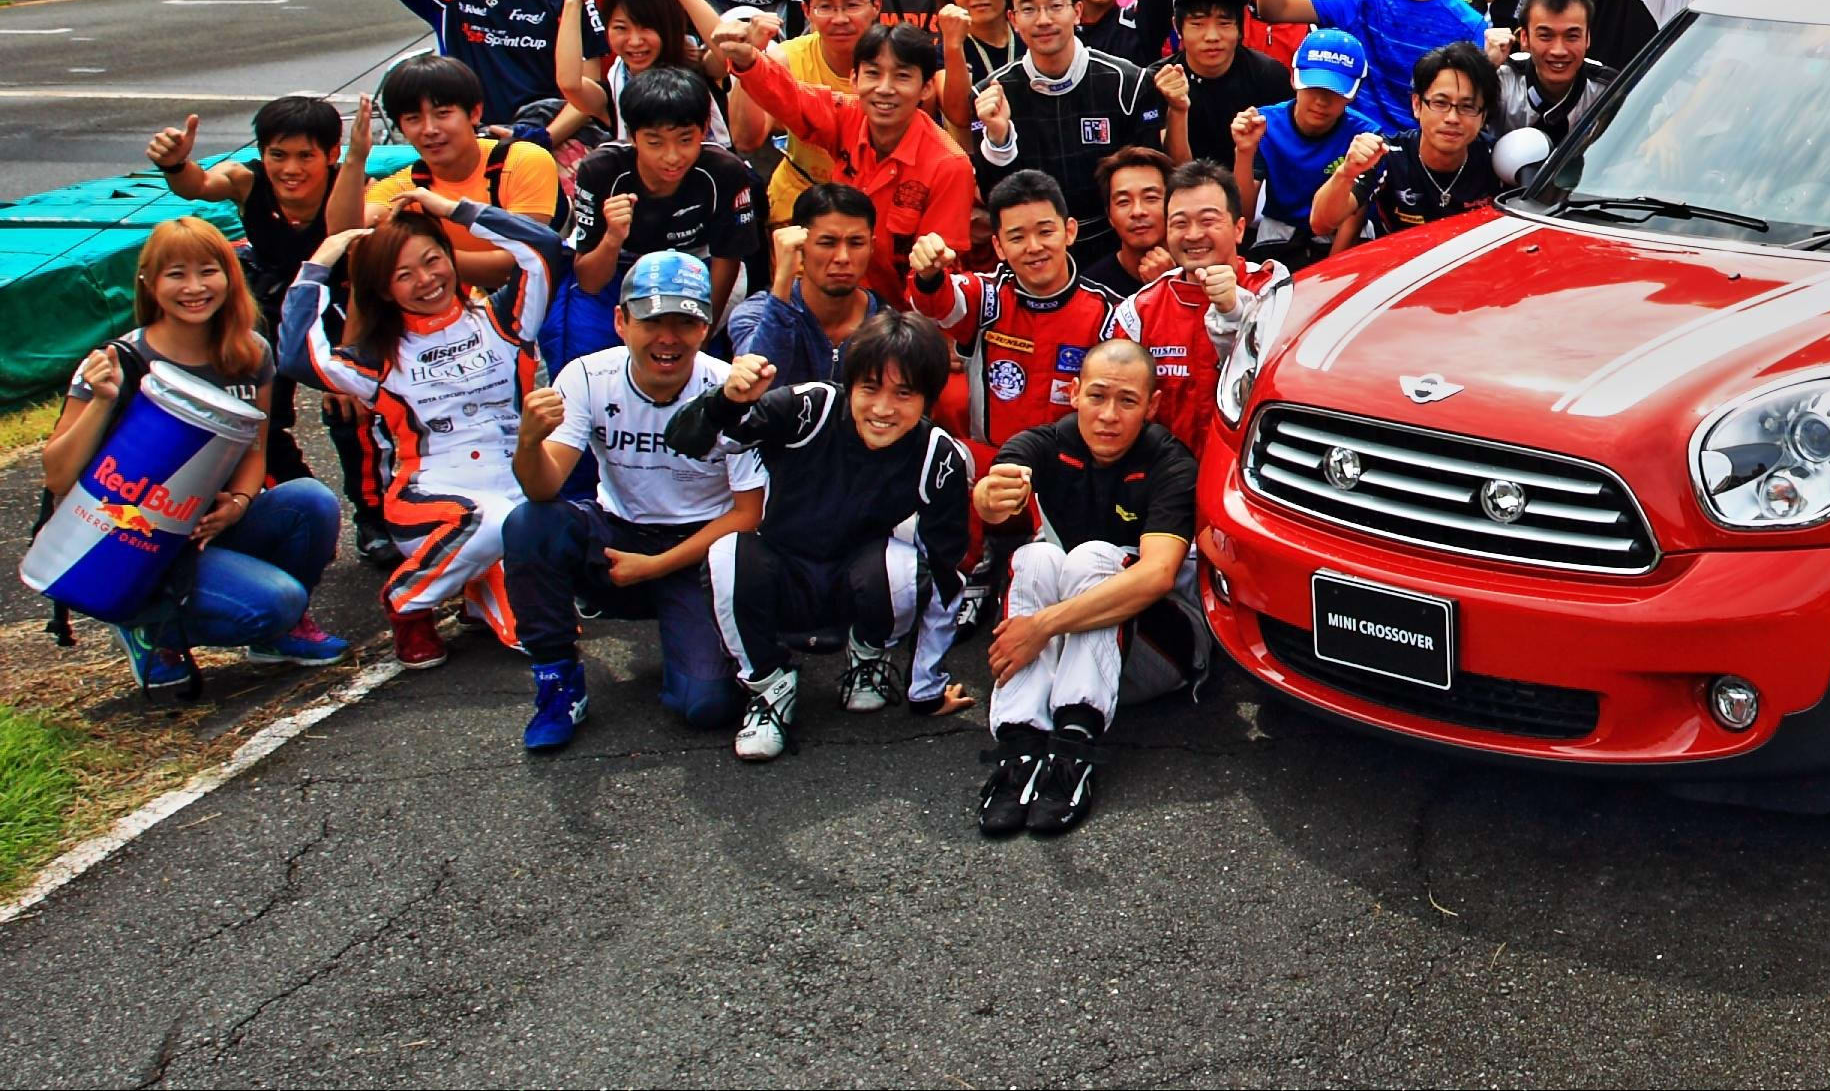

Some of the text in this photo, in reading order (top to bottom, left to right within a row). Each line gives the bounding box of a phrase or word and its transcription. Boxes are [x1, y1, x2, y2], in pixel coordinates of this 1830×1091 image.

[484, 32, 519, 47] Sprint
[520, 35, 547, 50] Cup
[1308, 49, 1355, 65] SUBARU
[995, 335, 1033, 351] DUNLOP
[1156, 365, 1190, 377] OTUL
[595, 426, 669, 455] SUPER
[93, 455, 204, 522] Red Bull
[119, 532, 161, 553] DRINK
[1327, 612, 1434, 651] MINI CROSSOVER
